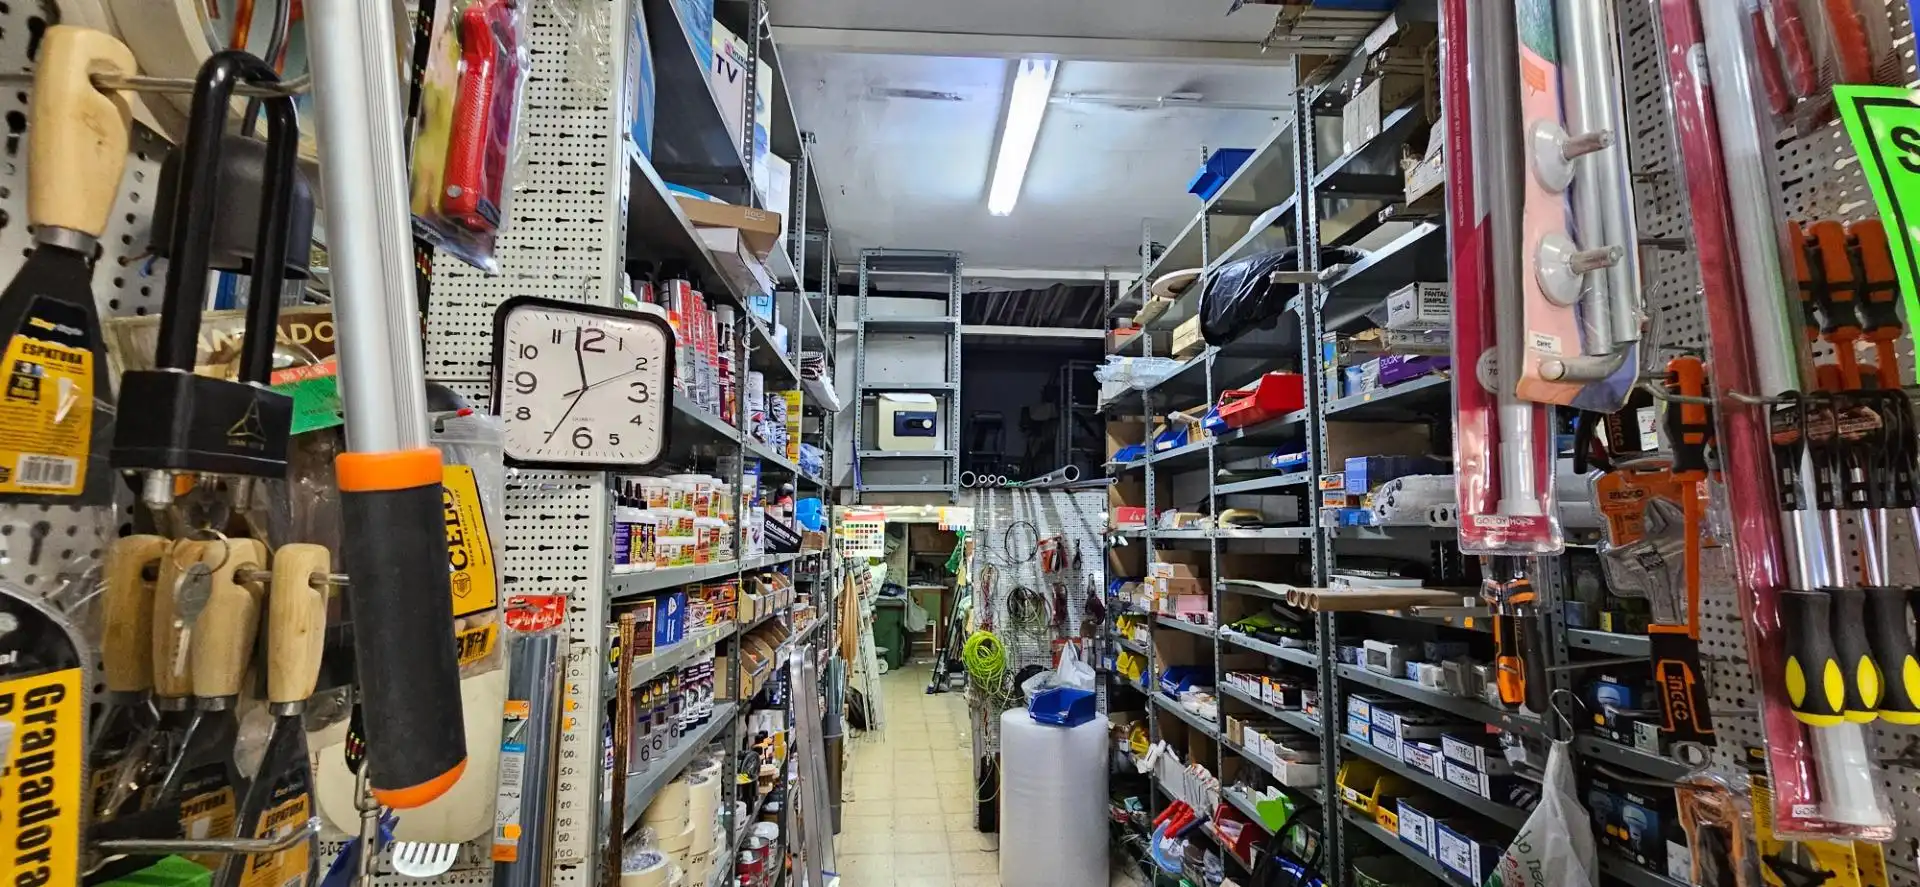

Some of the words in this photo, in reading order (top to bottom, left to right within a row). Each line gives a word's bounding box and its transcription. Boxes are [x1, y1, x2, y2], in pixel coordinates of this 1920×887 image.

[716, 53, 738, 83] TV
[552, 329, 562, 344] 11
[575, 326, 606, 353] 12
[618, 337, 623, 352] 1
[519, 344, 538, 360] 10
[635, 357, 648, 372] 2
[514, 371, 538, 395] 9
[627, 382, 650, 403] 3
[515, 407, 532, 421] 8
[629, 414, 643, 427] 4
[543, 431, 553, 444] 7
[572, 427, 593, 449] 6
[608, 433, 620, 446] 5
[670, 723, 679, 738] 6
[652, 734, 662, 750] 6
[641, 744, 649, 761] 6
[15, 683, 67, 887] Grapadora
